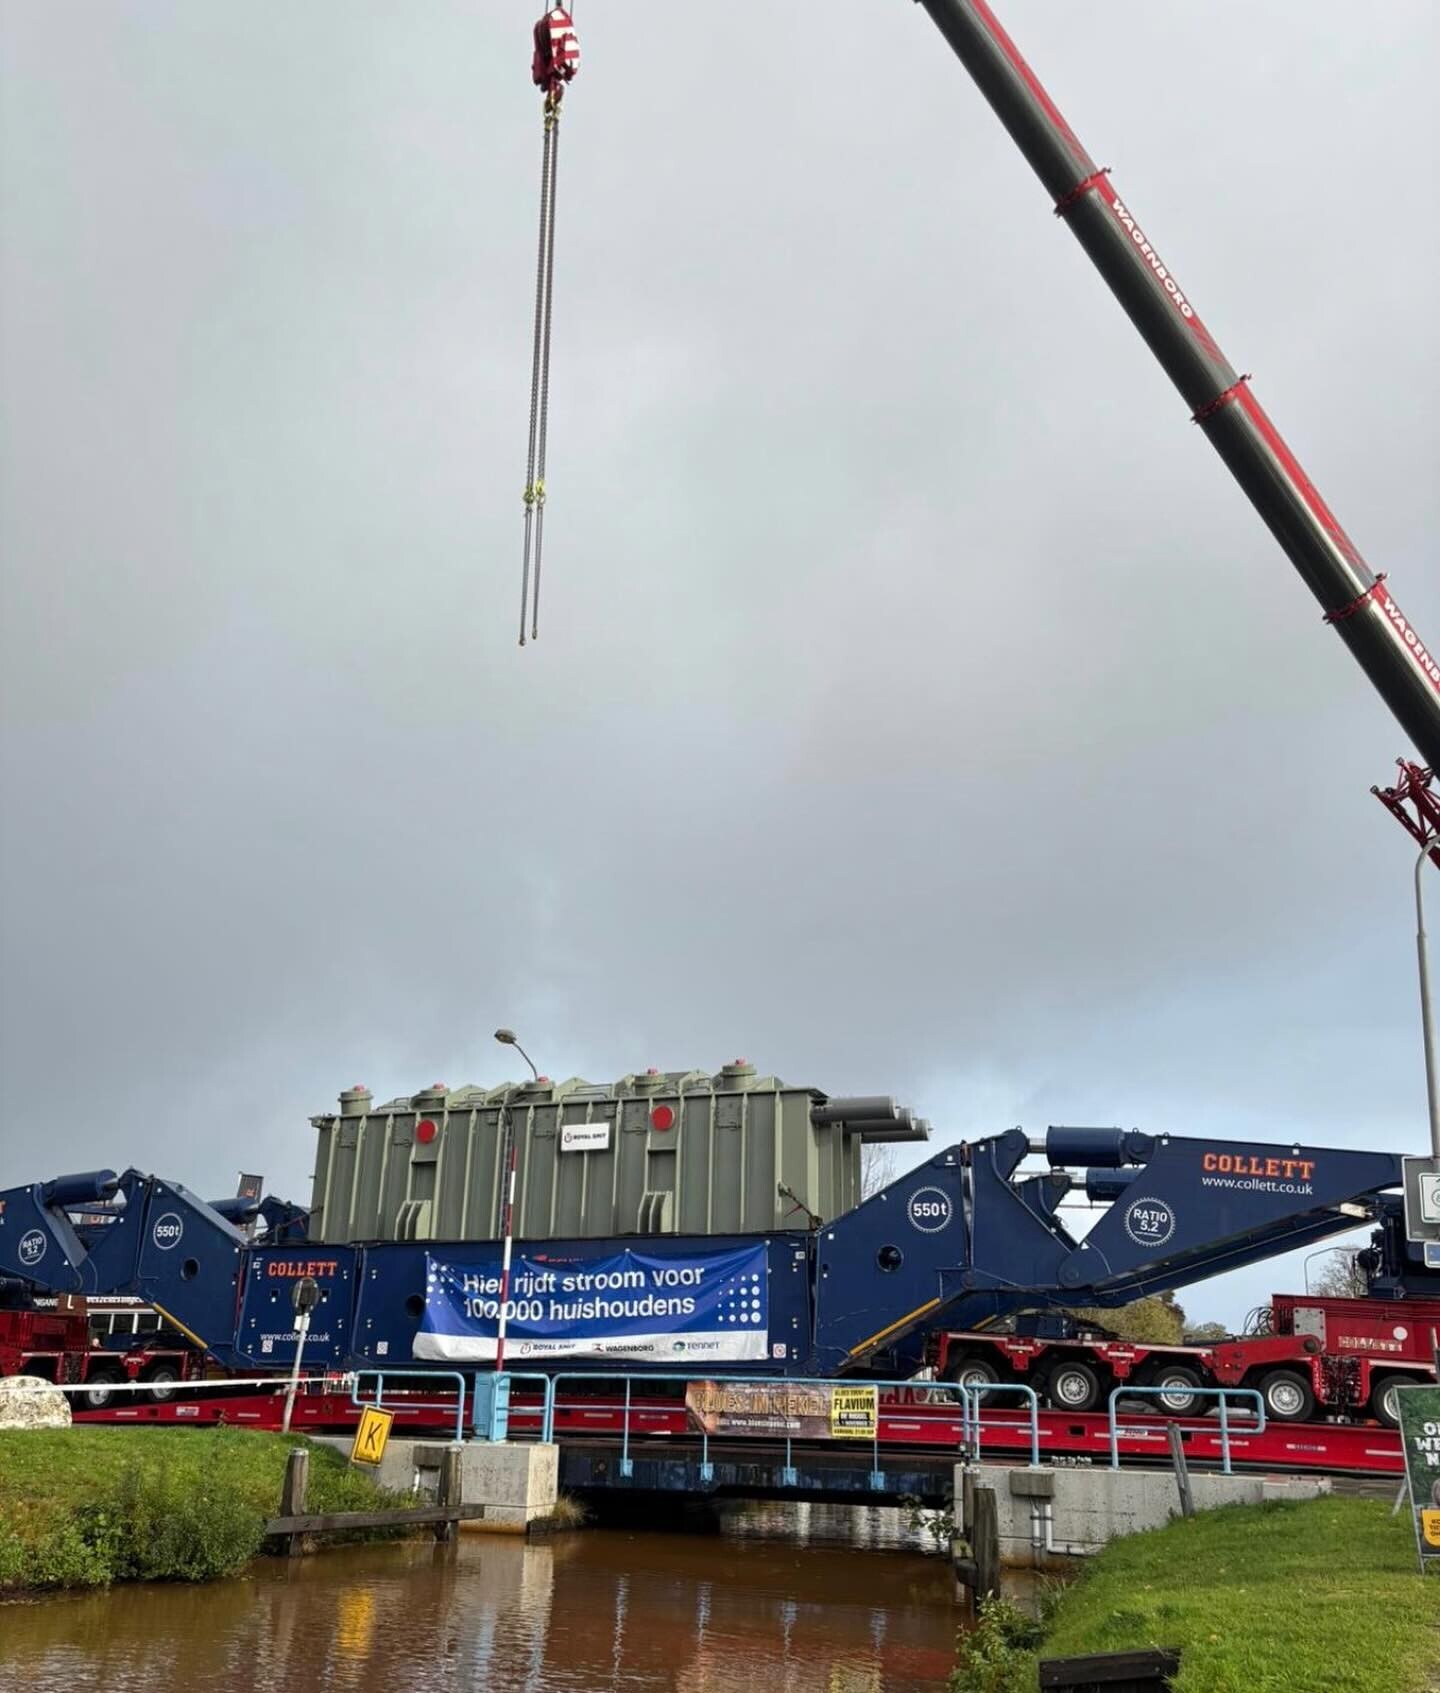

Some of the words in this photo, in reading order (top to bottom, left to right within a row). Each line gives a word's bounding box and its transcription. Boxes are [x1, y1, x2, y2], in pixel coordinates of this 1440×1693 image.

[1112, 197, 1193, 318] WAGENBORG
[1383, 596, 1440, 683] WAGENB
[1203, 1152, 1315, 1180] COLLETT
[1202, 1176, 1313, 1195] www.collett.co.uk
[1133, 1208, 1167, 1222] RATIO
[1140, 1220, 1159, 1233] 5.2
[22, 1236, 43, 1249] RATIO
[268, 1261, 337, 1277] COLLETT
[514, 1272, 556, 1297] rijdt
[562, 1270, 645, 1292] stroom
[652, 1267, 705, 1287] voor
[463, 1298, 543, 1321] 100.000
[550, 1293, 696, 1321] huishoudens
[605, 1344, 654, 1352] WAGENBORG
[834, 1398, 875, 1410] FLAVIUM
[365, 1421, 382, 1451] K
